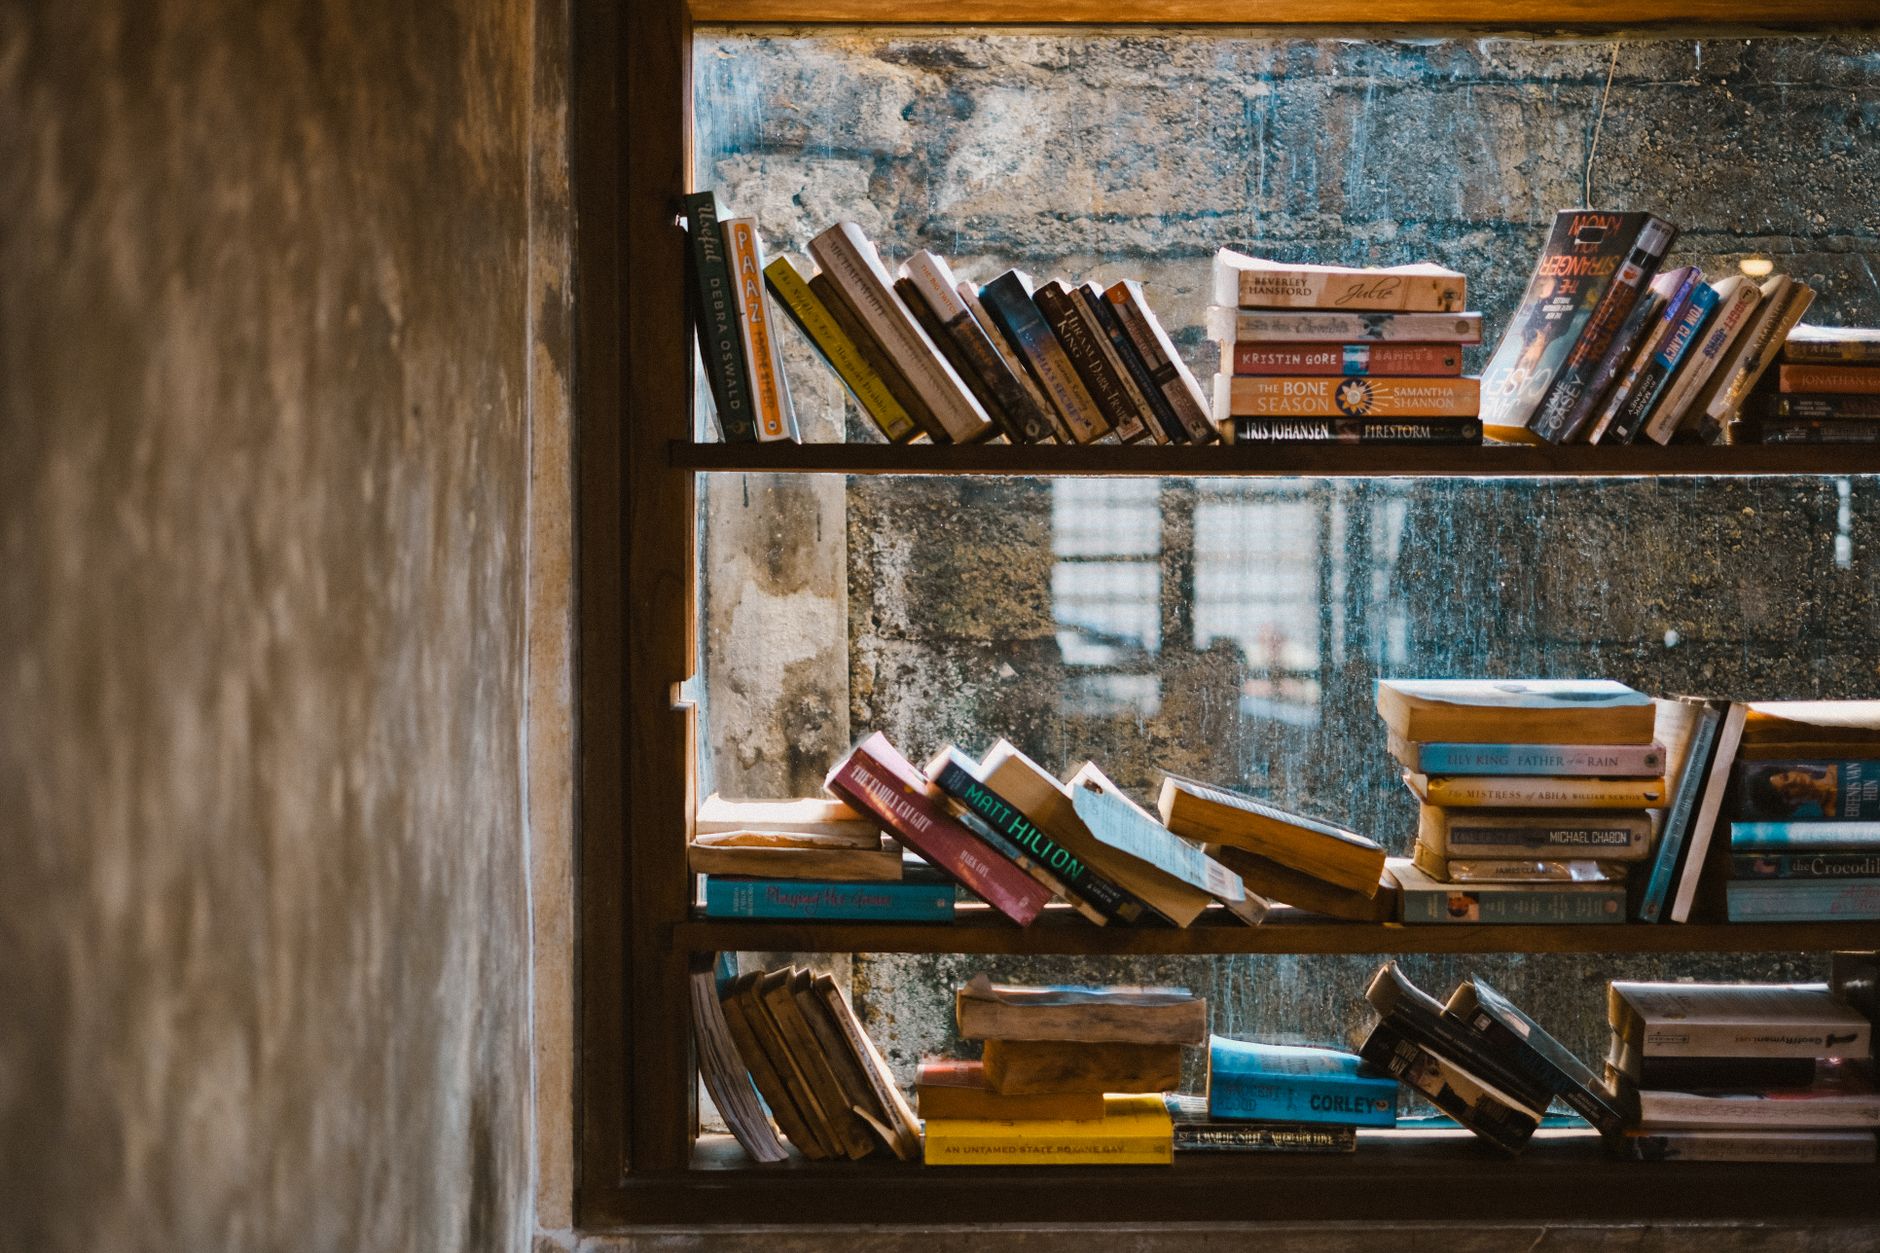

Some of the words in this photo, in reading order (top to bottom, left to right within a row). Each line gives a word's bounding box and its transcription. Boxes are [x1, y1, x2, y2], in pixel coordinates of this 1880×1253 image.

[698, 203, 721, 263] Useful
[1539, 256, 1621, 275] STRANGER
[738, 231, 761, 323] PAAZ
[1254, 277, 1307, 287] BEVERLEY
[1558, 279, 1579, 294] THE
[1249, 286, 1311, 296] HANSFORD
[1334, 274, 1401, 307] Julie
[1686, 303, 1703, 326] TOM
[1057, 319, 1083, 358] KING
[1064, 309, 1099, 357] HIRAM
[710, 278, 728, 333] DEBRA
[721, 340, 740, 409] OSWALD
[1662, 323, 1691, 364] CLANCY
[1242, 353, 1300, 364] KRISTIN
[1305, 353, 1336, 364] GORE
[1258, 383, 1279, 392] THE
[1283, 381, 1328, 395] BONE
[1482, 368, 1552, 396] CASEY
[1801, 375, 1864, 385] JONATHAN
[1393, 386, 1454, 396] SAMANTHA
[1628, 375, 1653, 416] GREANEY
[1257, 397, 1328, 411] SEASON
[1393, 398, 1454, 408] SHANNON
[1549, 374, 1584, 429] CASEY
[1636, 391, 1652, 416] MARK
[1246, 421, 1268, 439] IRIS
[1270, 421, 1328, 443] JOHANSEN
[1364, 423, 1430, 438] FIRESTORM
[1448, 755, 1471, 764] LILY
[1476, 756, 1508, 765] KING
[1518, 756, 1564, 766] FATHER
[1587, 757, 1618, 766] RAIN
[850, 764, 869, 785] THE
[866, 777, 899, 808] FAMILY
[1466, 789, 1520, 799] MISTRESS
[1525, 791, 1534, 800] of
[1538, 790, 1567, 800] ABHA
[965, 783, 1011, 823] MATT
[1007, 815, 1084, 880] HILTON
[1549, 831, 1589, 843] MICHAEL
[1591, 831, 1627, 842] CHABON
[1792, 860, 1808, 870] the
[1309, 1094, 1375, 1113] CORLEY
[963, 1146, 1015, 1154] UNTAMED
